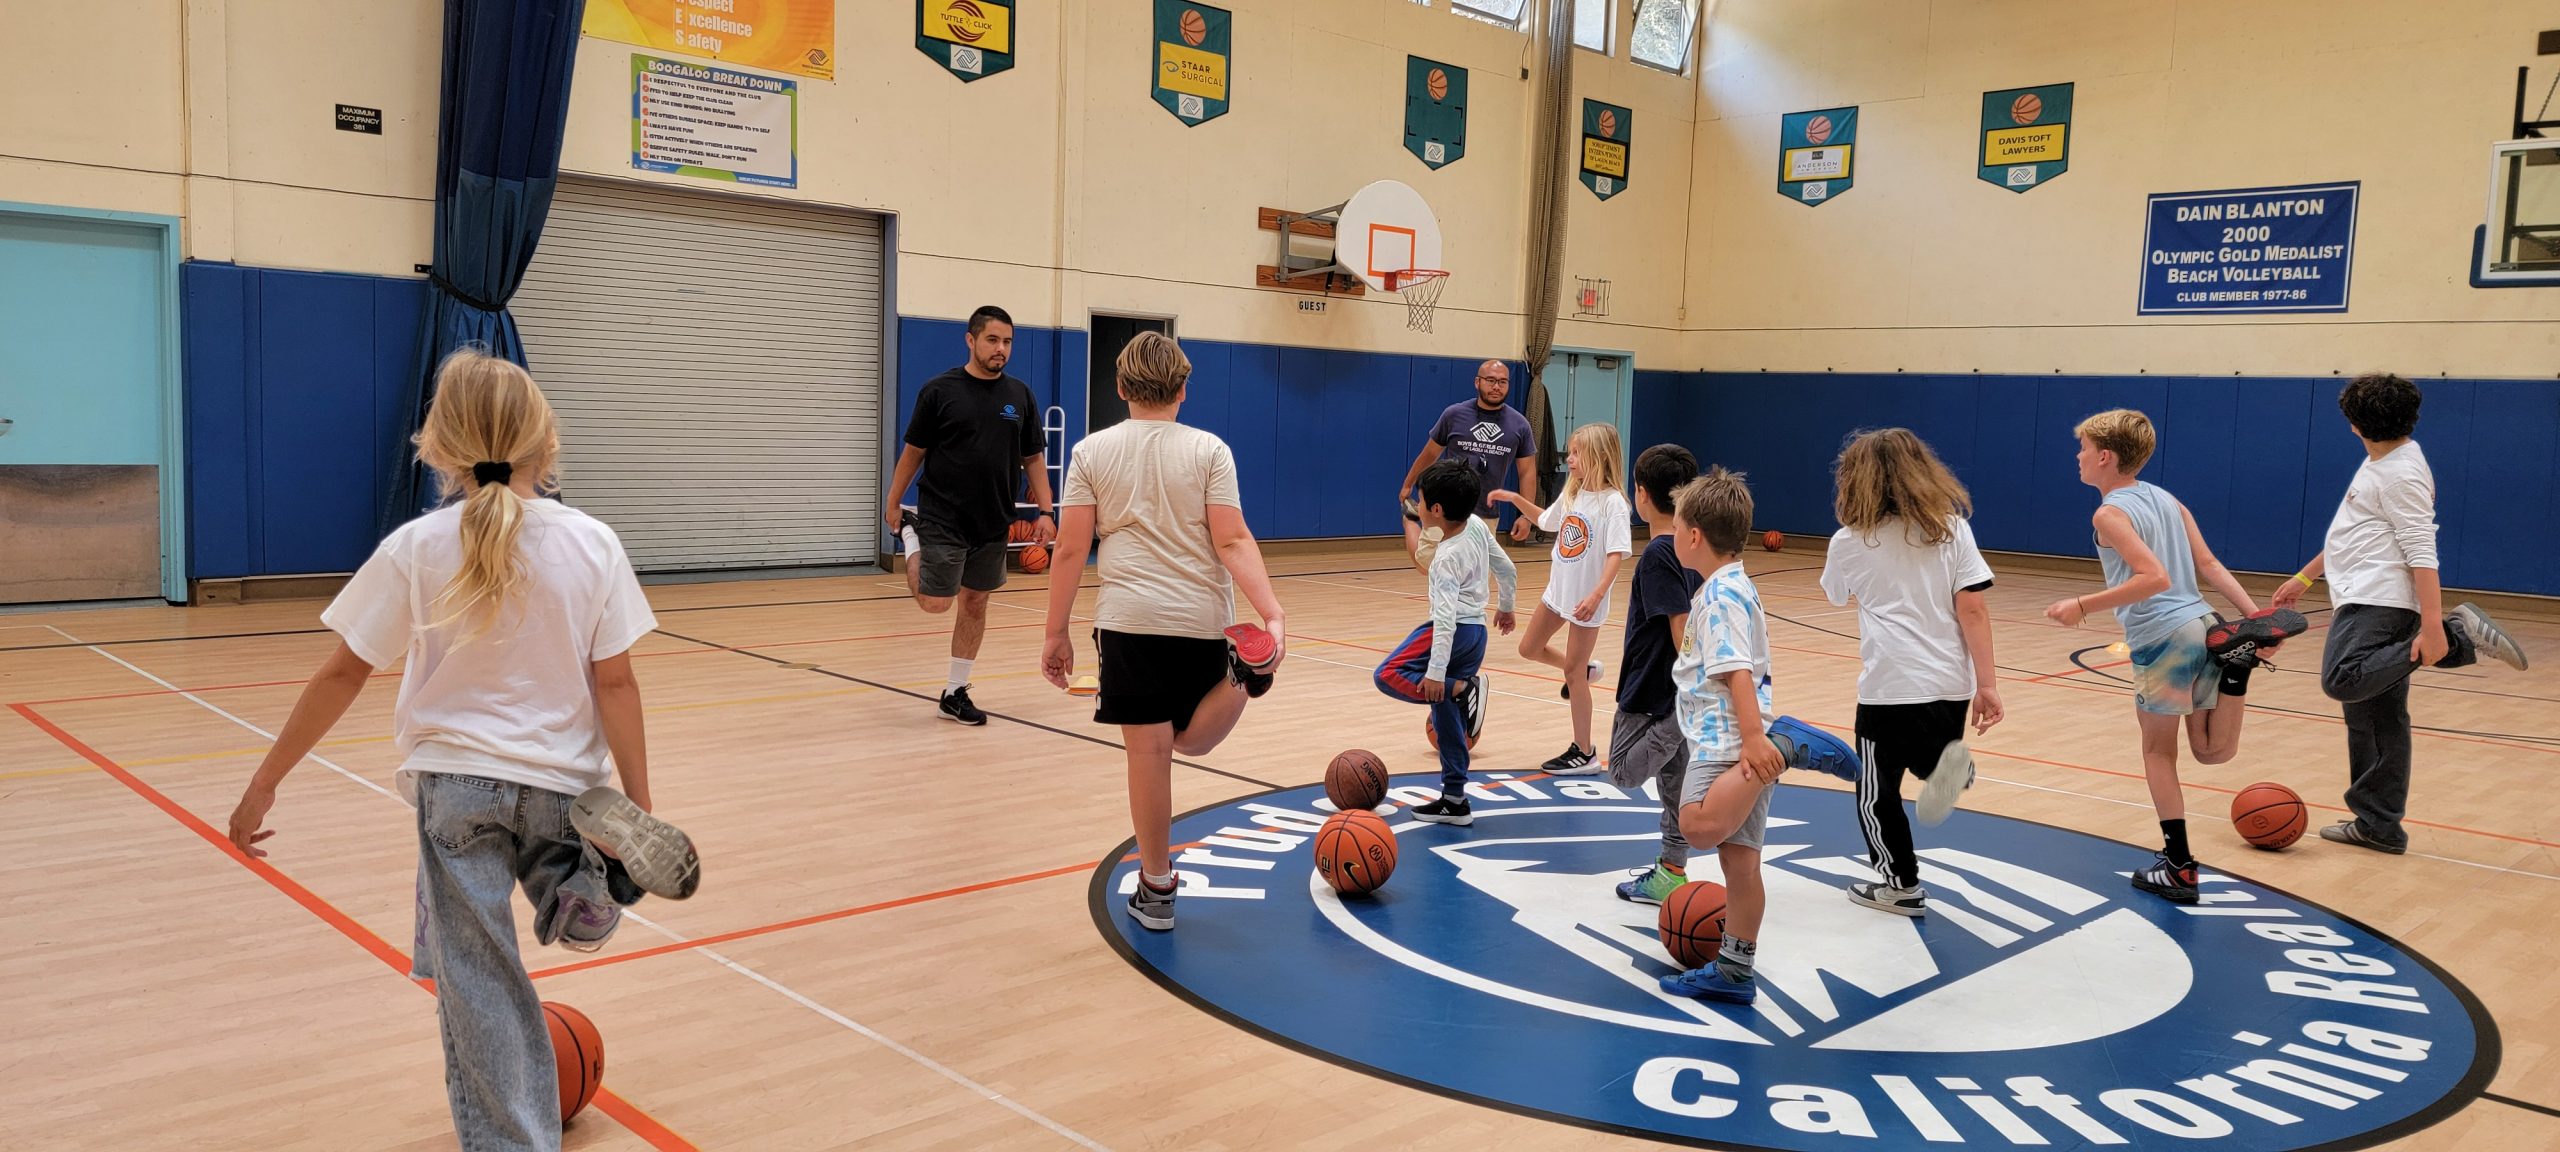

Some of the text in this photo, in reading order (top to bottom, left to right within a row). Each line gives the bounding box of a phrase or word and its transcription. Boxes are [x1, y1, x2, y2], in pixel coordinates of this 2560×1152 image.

[941, 13, 992, 30] TUTTLE CLICK
[1181, 60, 1210, 73] STAAR
[648, 60, 782, 91] BOOGALOO BREAK DOWN
[1181, 71, 1224, 87] SURGICAL
[653, 78, 687, 88] RESPECTFUL
[696, 85, 724, 95] EVERYONE
[338, 114, 380, 125] OCCUPANCY
[342, 107, 375, 117] MAXIMUM
[1998, 133, 2052, 145] DAVIS TOFT
[2002, 145, 2046, 155] LAWYERS
[1797, 161, 1838, 169] ANDERSON
[2176, 199, 2324, 222] DAIN BLANTON
[2222, 226, 2271, 243] 2000
[2151, 245, 2344, 265] OLYMPIC GOLD MEDALIST
[2167, 266, 2321, 283] BEACH VOLLEYBALL
[2176, 290, 2307, 302] CLUB MEMBER 1977-86
[1299, 301, 1326, 312] GUEST
[1361, 761, 1386, 801] PALDING
[1633, 1020, 2433, 1146] California
